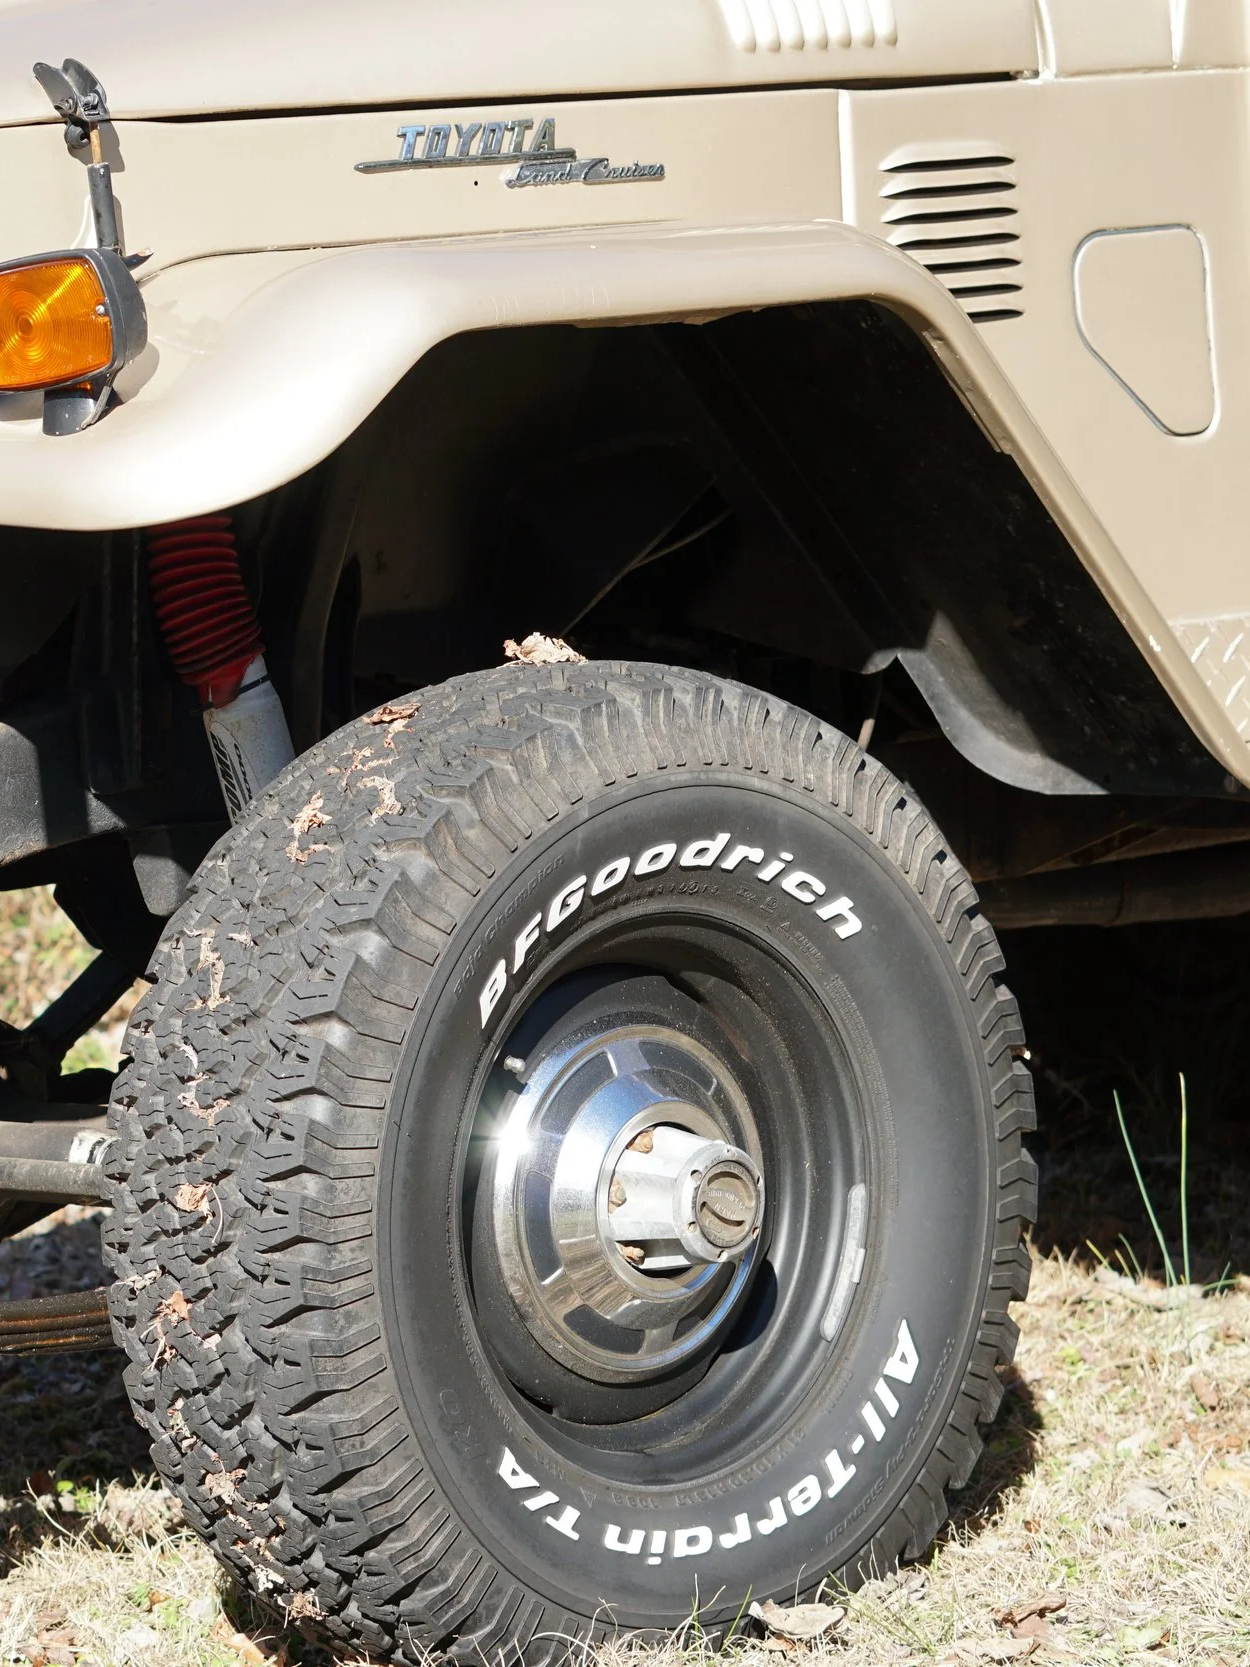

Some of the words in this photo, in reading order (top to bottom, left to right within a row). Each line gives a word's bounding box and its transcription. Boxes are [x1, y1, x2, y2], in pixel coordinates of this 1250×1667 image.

[397, 118, 555, 160] TOYOTA
[506, 162, 572, 188] Land
[581, 157, 665, 182] Cruiser
[234, 743, 253, 800] 000
[480, 832, 863, 1029] BFGoodrich
[484, 854, 566, 945] Champion
[605, 1318, 919, 1565] All-Terrain
[498, 1447, 580, 1540] T/A
[825, 1477, 886, 1546] Sidewall
